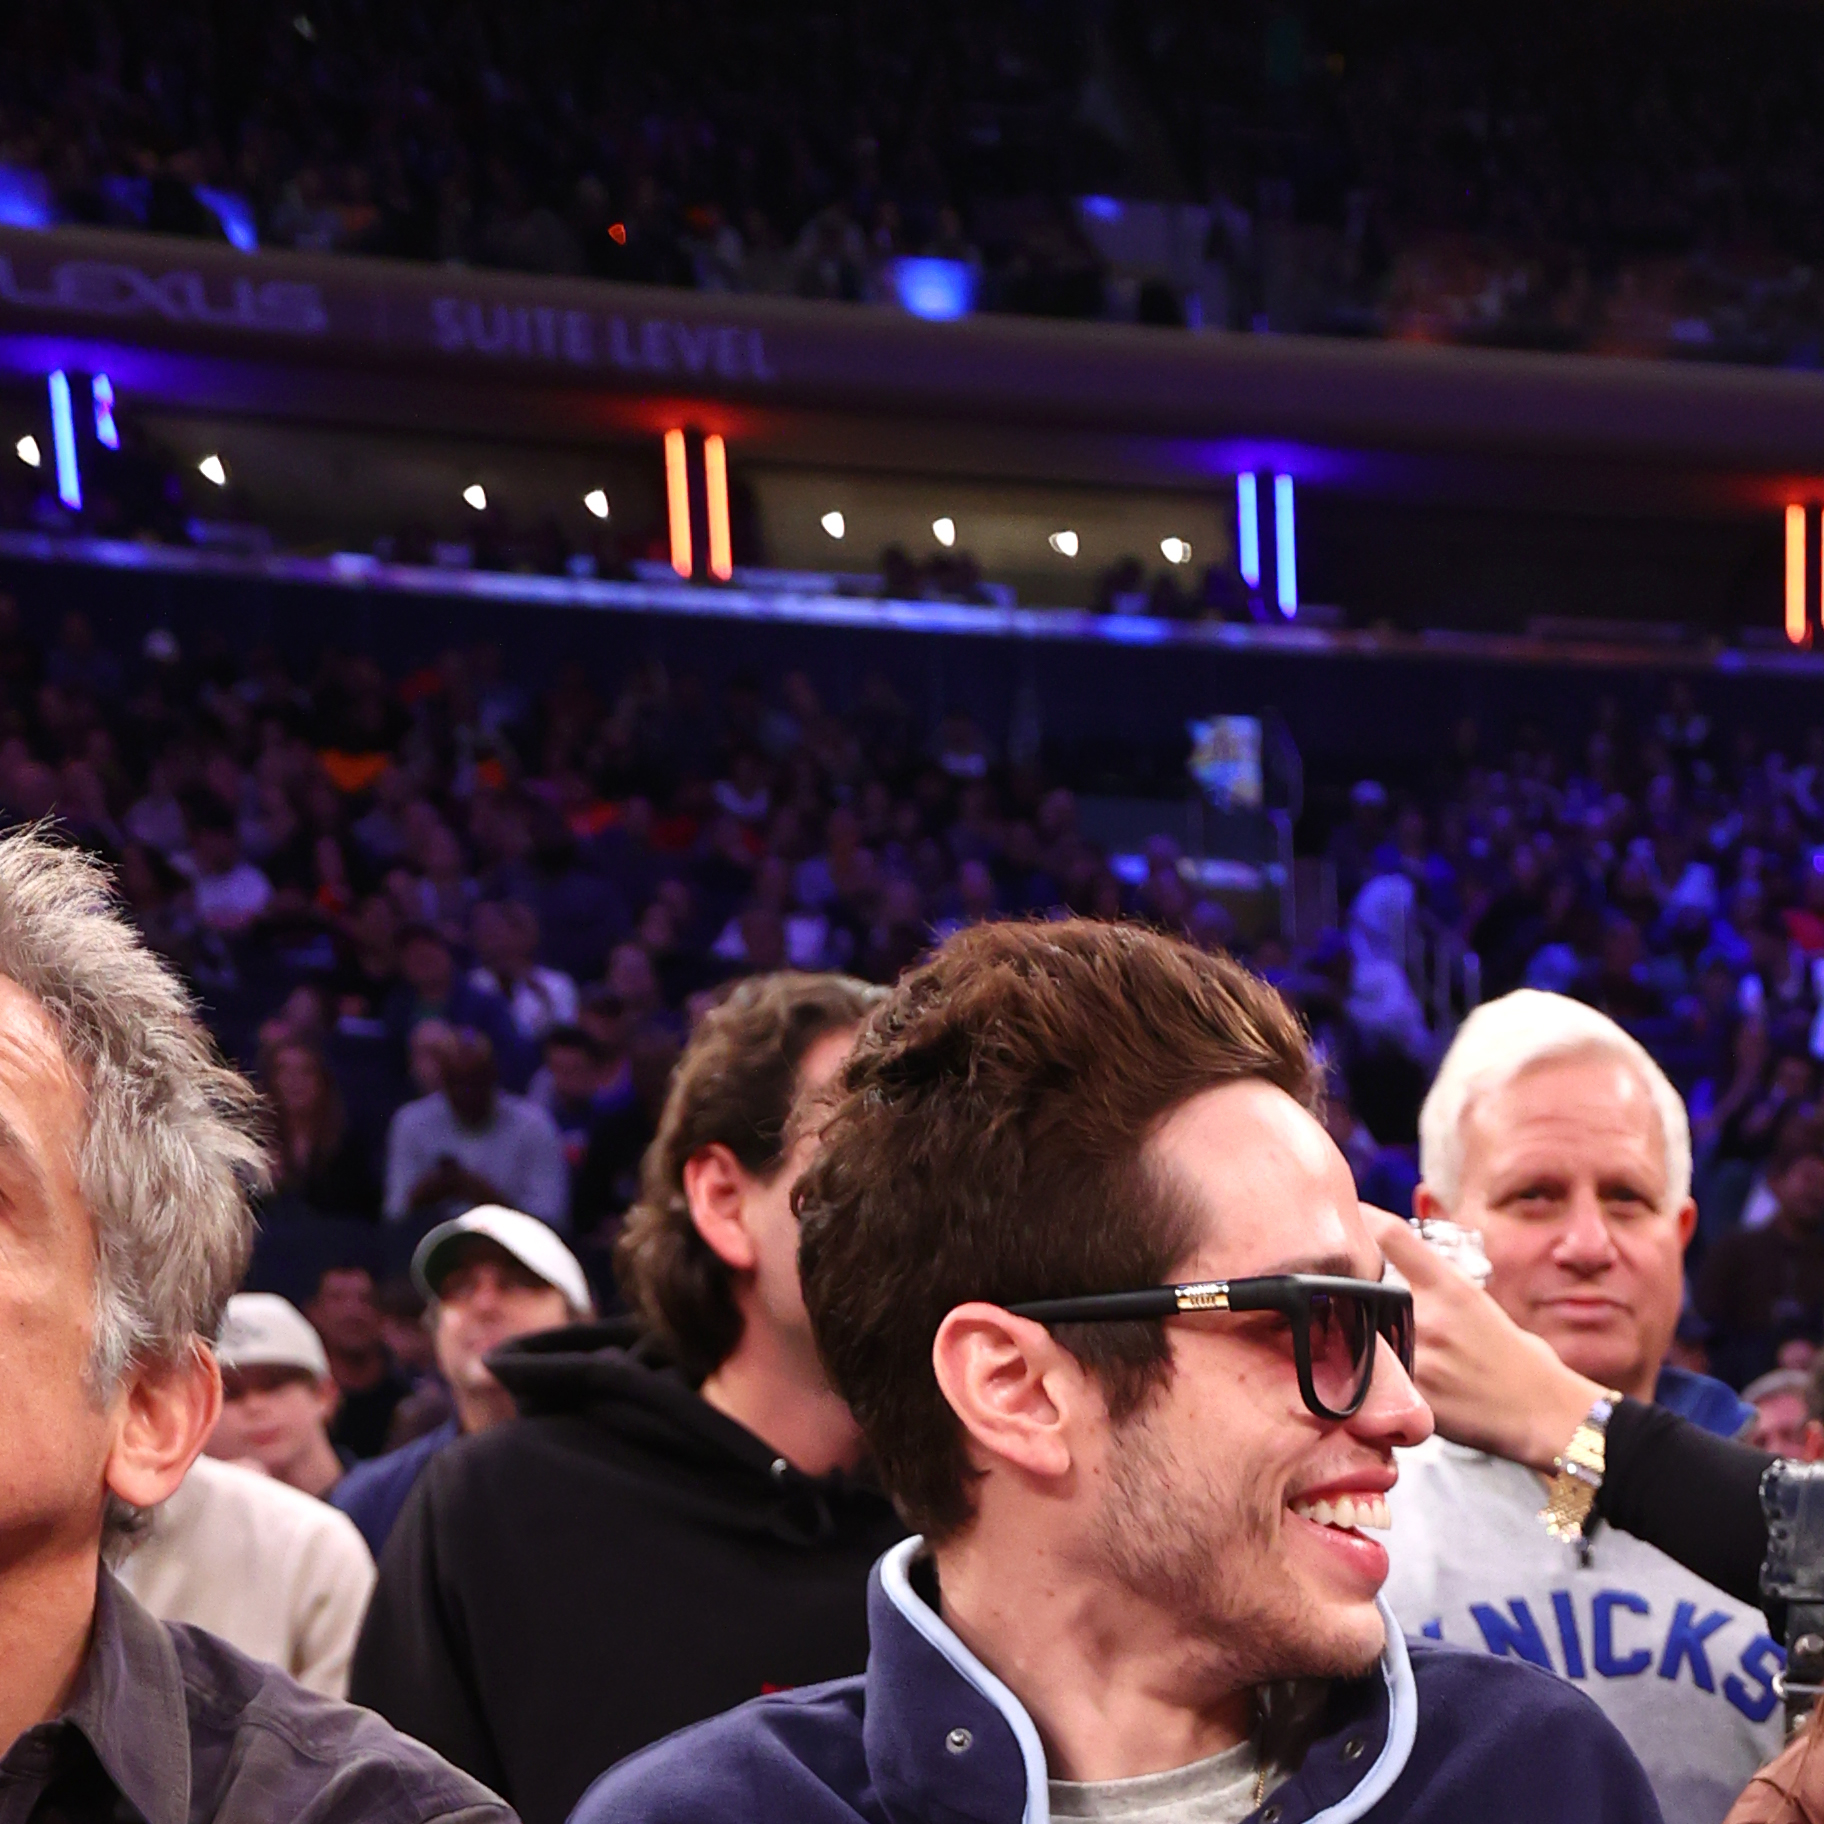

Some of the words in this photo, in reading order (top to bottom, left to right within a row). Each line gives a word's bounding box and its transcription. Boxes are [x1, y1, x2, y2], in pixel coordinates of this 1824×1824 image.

[431, 298, 595, 366] SUITE
[609, 316, 774, 382] LEVEL
[1421, 1588, 1788, 1723] NICKS
